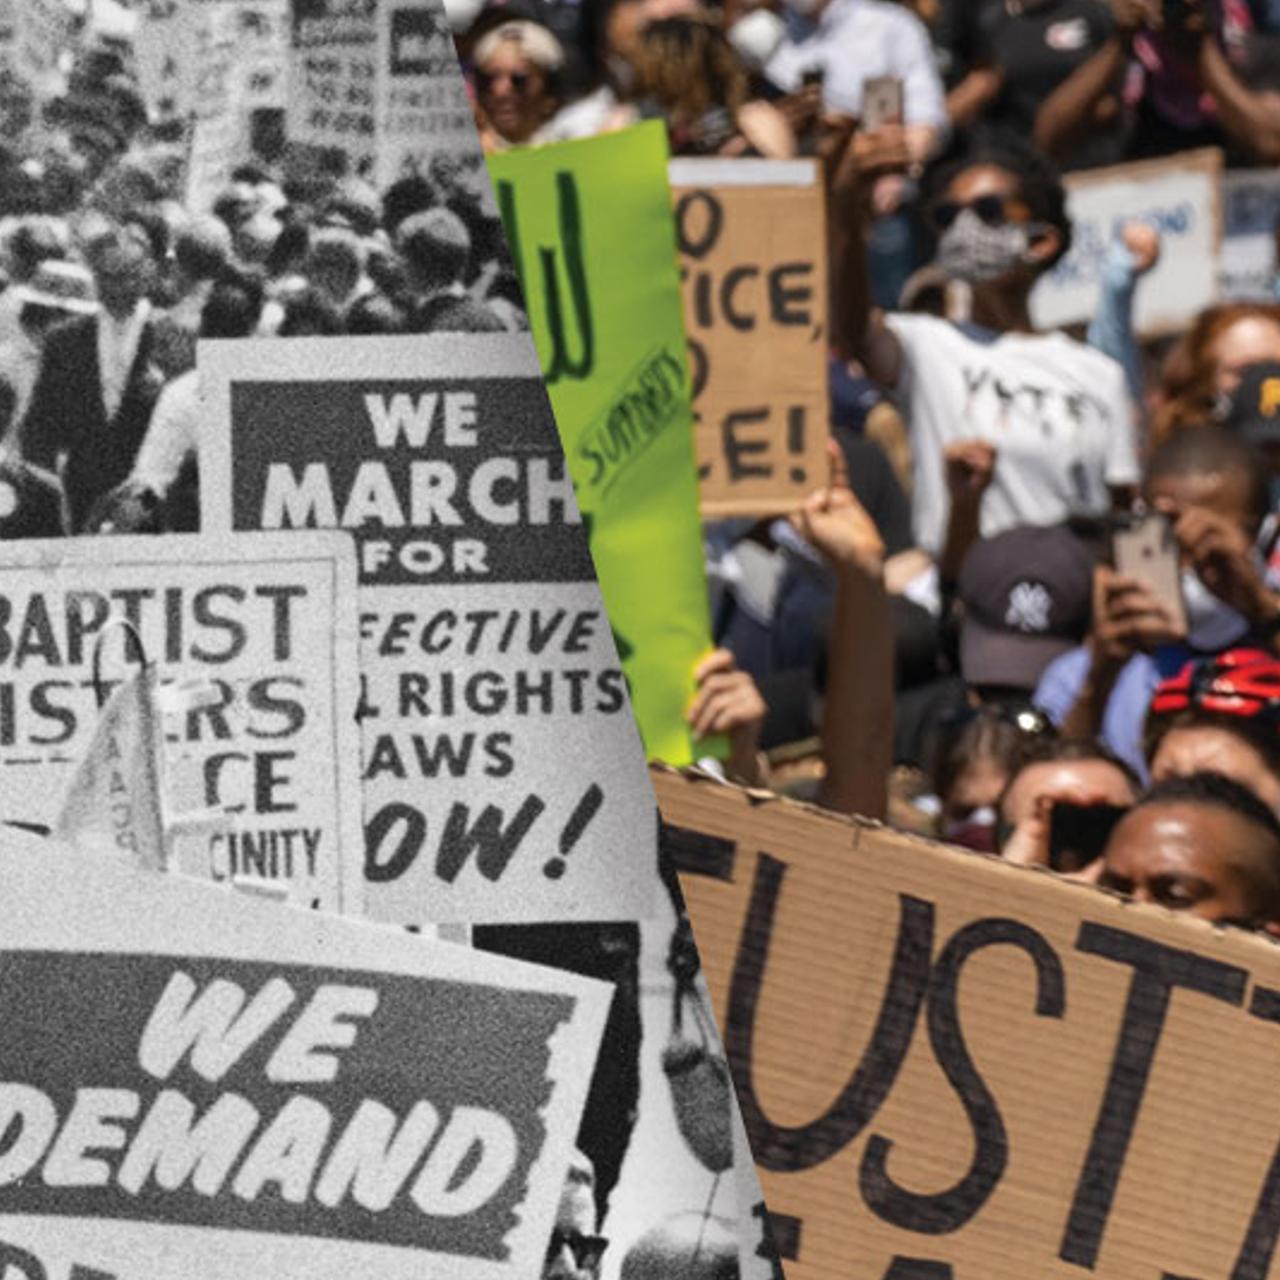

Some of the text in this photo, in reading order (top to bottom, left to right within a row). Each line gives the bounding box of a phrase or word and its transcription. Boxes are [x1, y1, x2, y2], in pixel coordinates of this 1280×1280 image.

[678, 261, 822, 344] ICE,
[363, 391, 480, 448] WE
[260, 457, 583, 530] MARCH
[362, 538, 490, 575] FOR
[398, 669, 627, 717] RIGHTS
[137, 969, 378, 1083] WE
